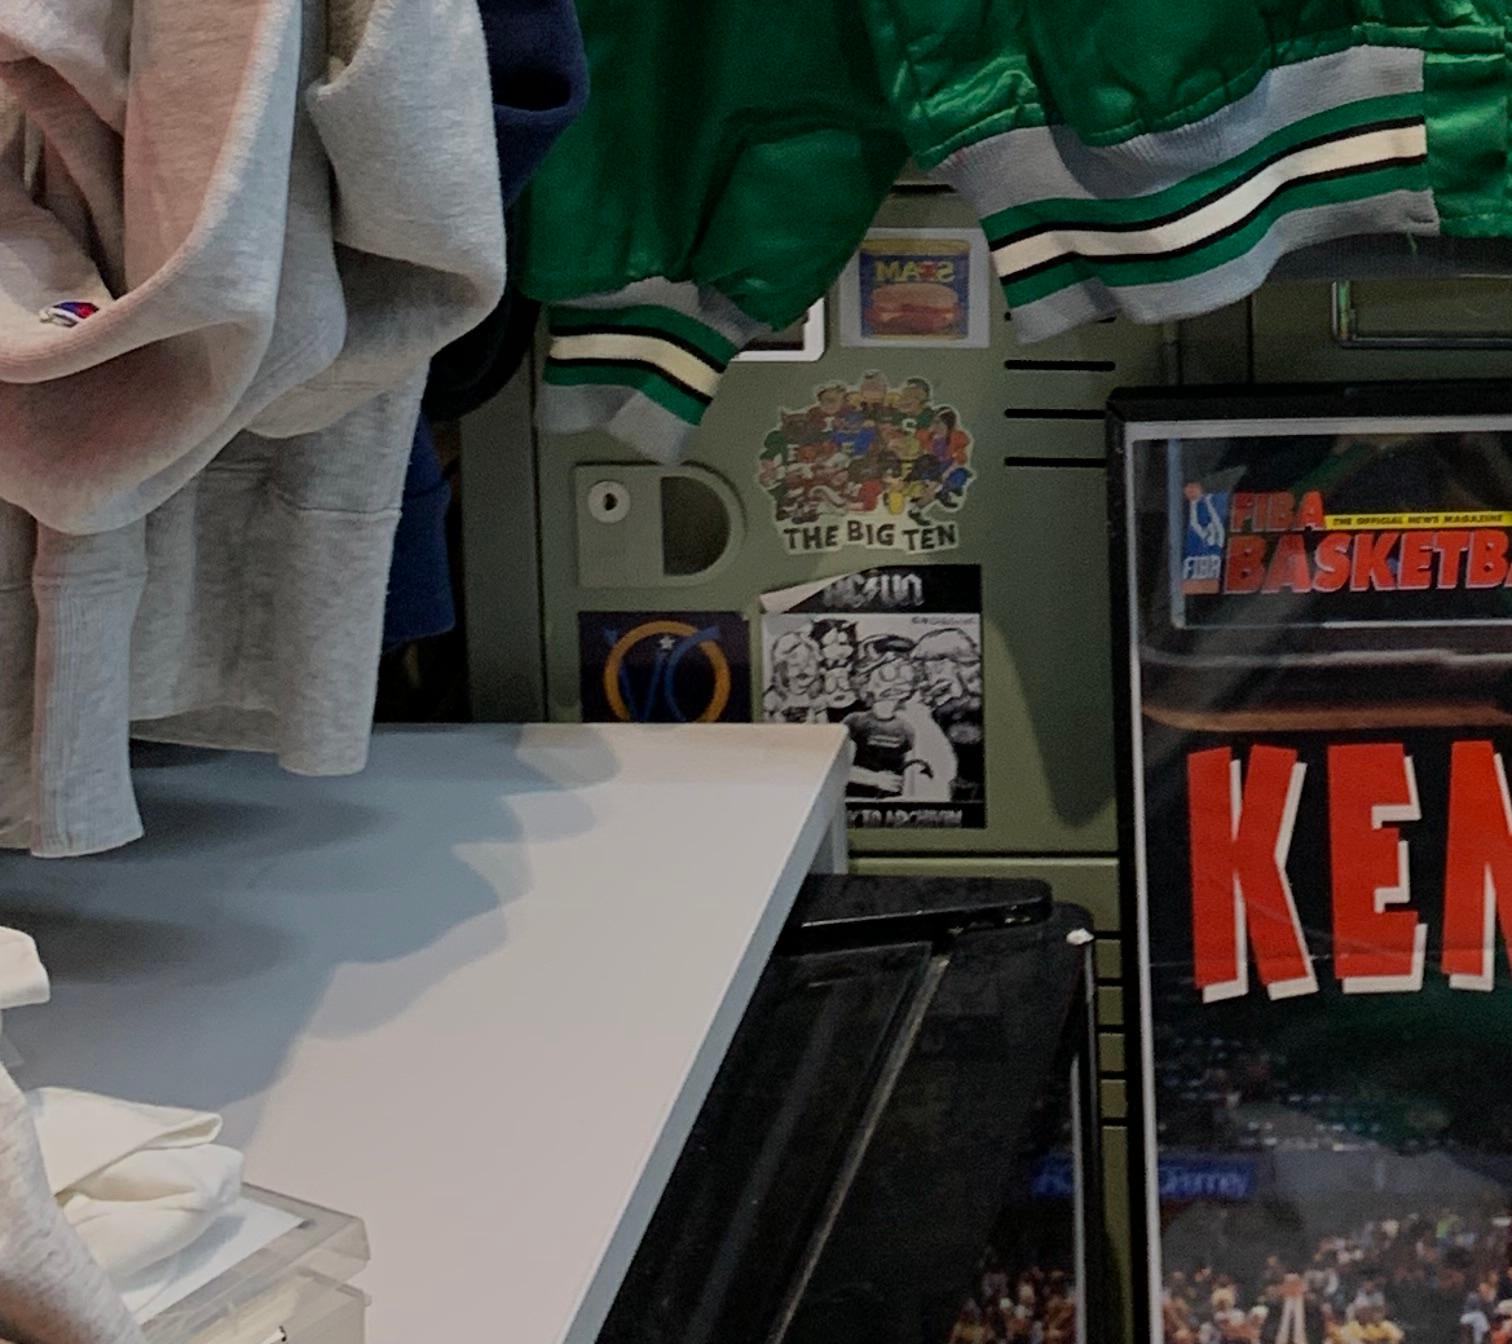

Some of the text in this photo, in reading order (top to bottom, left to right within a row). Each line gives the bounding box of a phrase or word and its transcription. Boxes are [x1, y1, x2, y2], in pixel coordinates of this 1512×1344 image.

[1229, 488, 1328, 533] FIBA
[783, 519, 956, 551] THE BIG TEN
